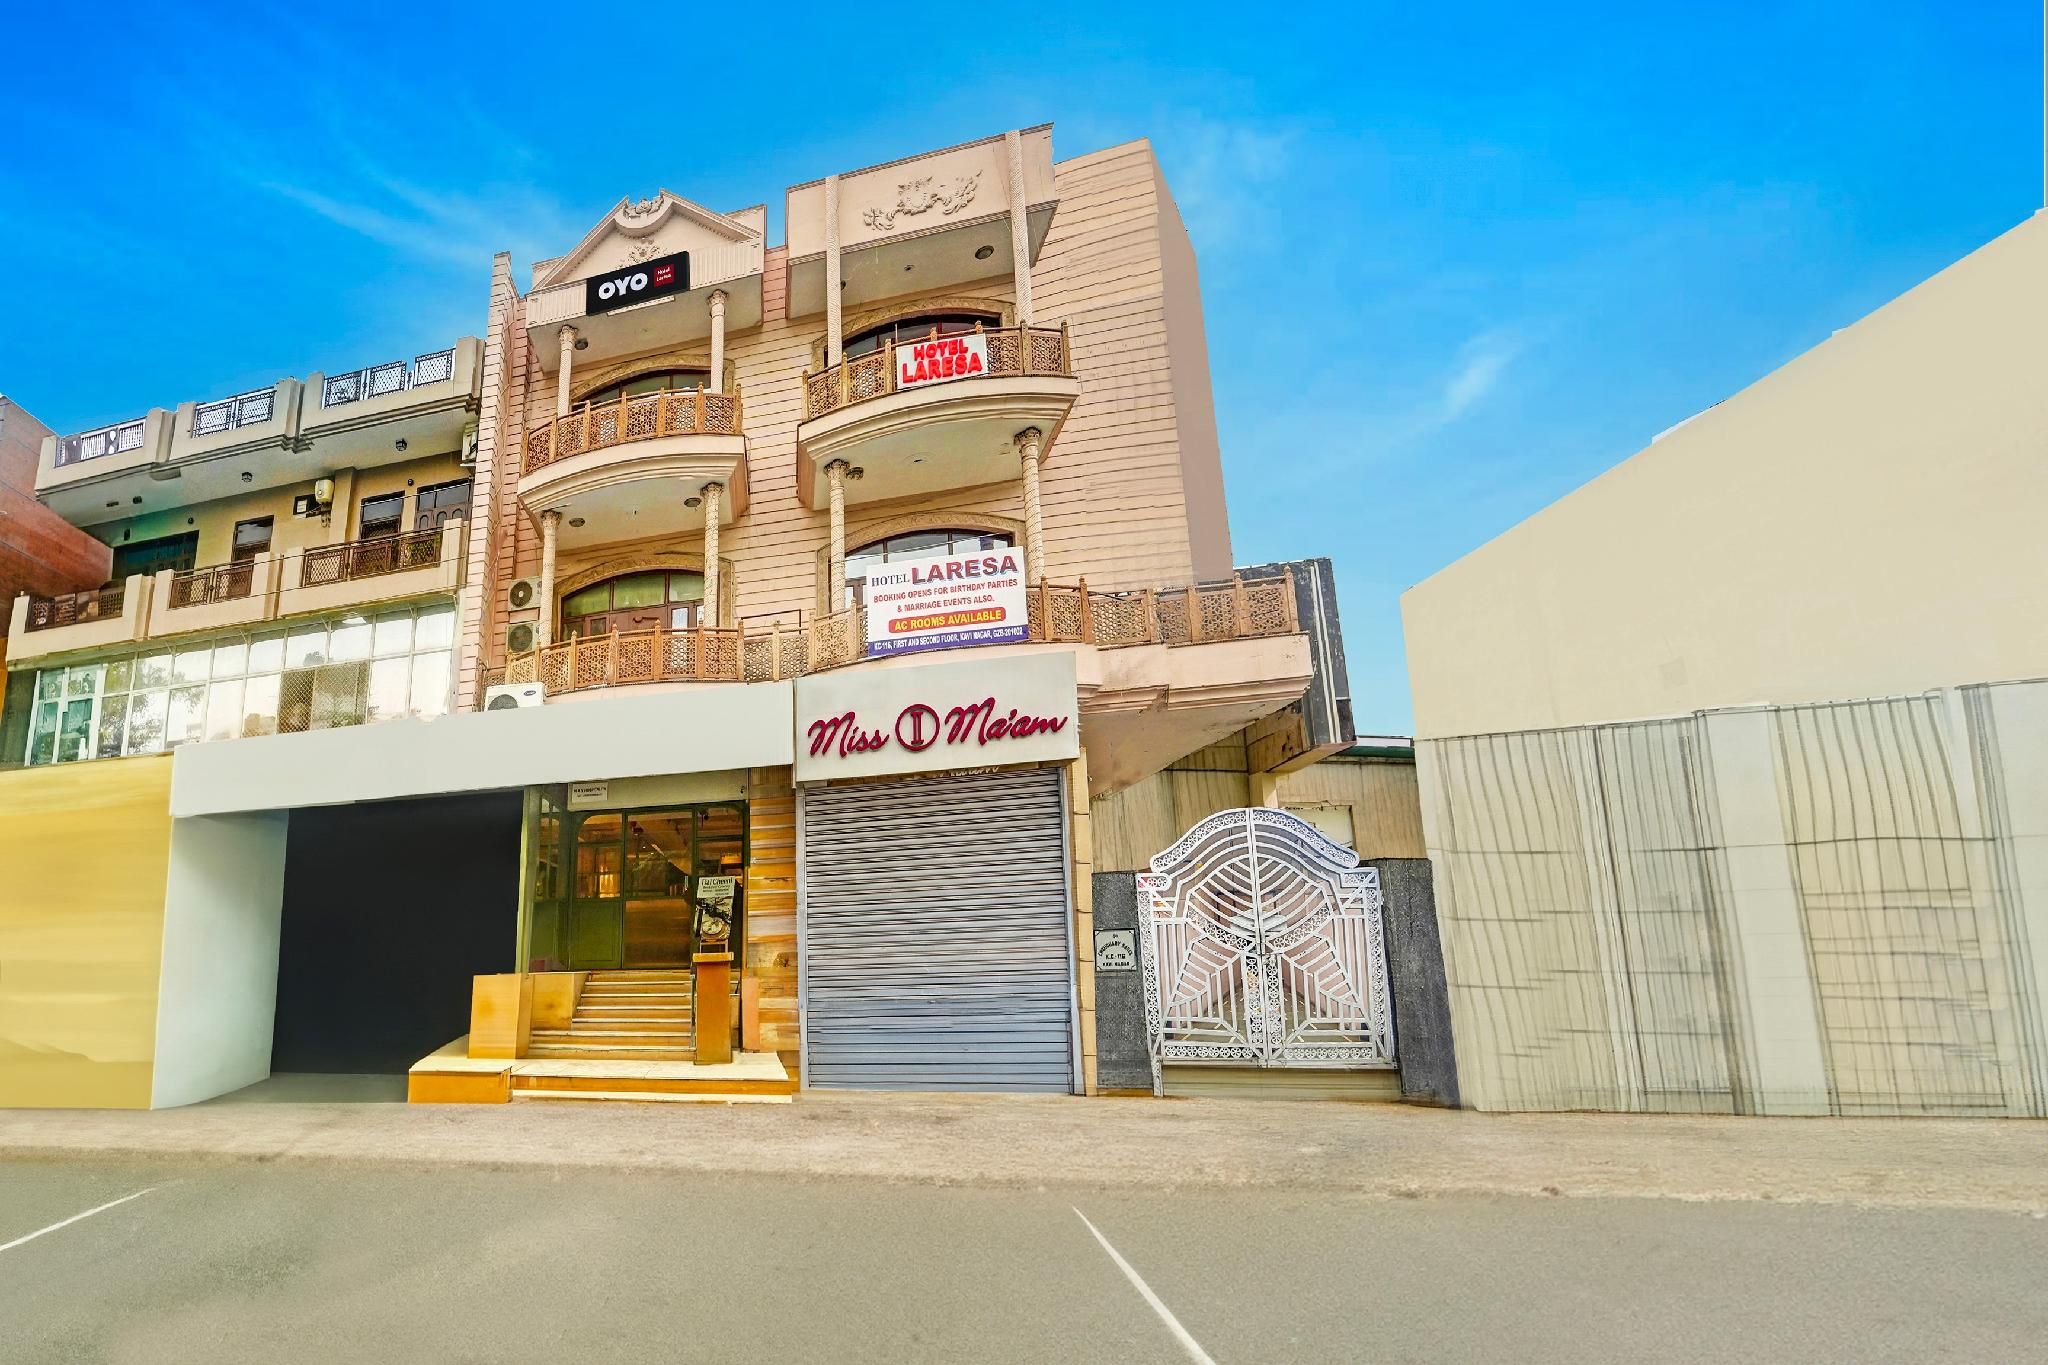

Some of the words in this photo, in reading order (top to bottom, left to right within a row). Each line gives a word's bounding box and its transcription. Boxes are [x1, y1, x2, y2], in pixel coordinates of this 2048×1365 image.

[598, 272, 648, 300] OYO
[913, 338, 969, 361] HOTEL
[902, 351, 983, 384] LARESA
[871, 573, 910, 587] HOTEL
[911, 555, 1019, 585] LARESA
[873, 592, 906, 604] BOOKING
[907, 588, 933, 599] OPENS
[933, 585, 948, 596] FOR
[949, 582, 986, 594] BIRTHDAY
[987, 578, 1018, 590] PARTIES
[897, 604, 902, 613] &
[903, 600, 942, 613] MARRIAGE
[943, 597, 972, 607] EVENTS
[894, 621, 908, 631] AC
[910, 616, 946, 629] ROOMS
[948, 610, 1002, 625] AVAILABLE
[893, 639, 908, 649] FIRST
[908, 637, 920, 647] AND
[920, 634, 941, 646] SECOND
[807, 711, 890, 759] Miss
[944, 696, 1068, 746] Ma'am
